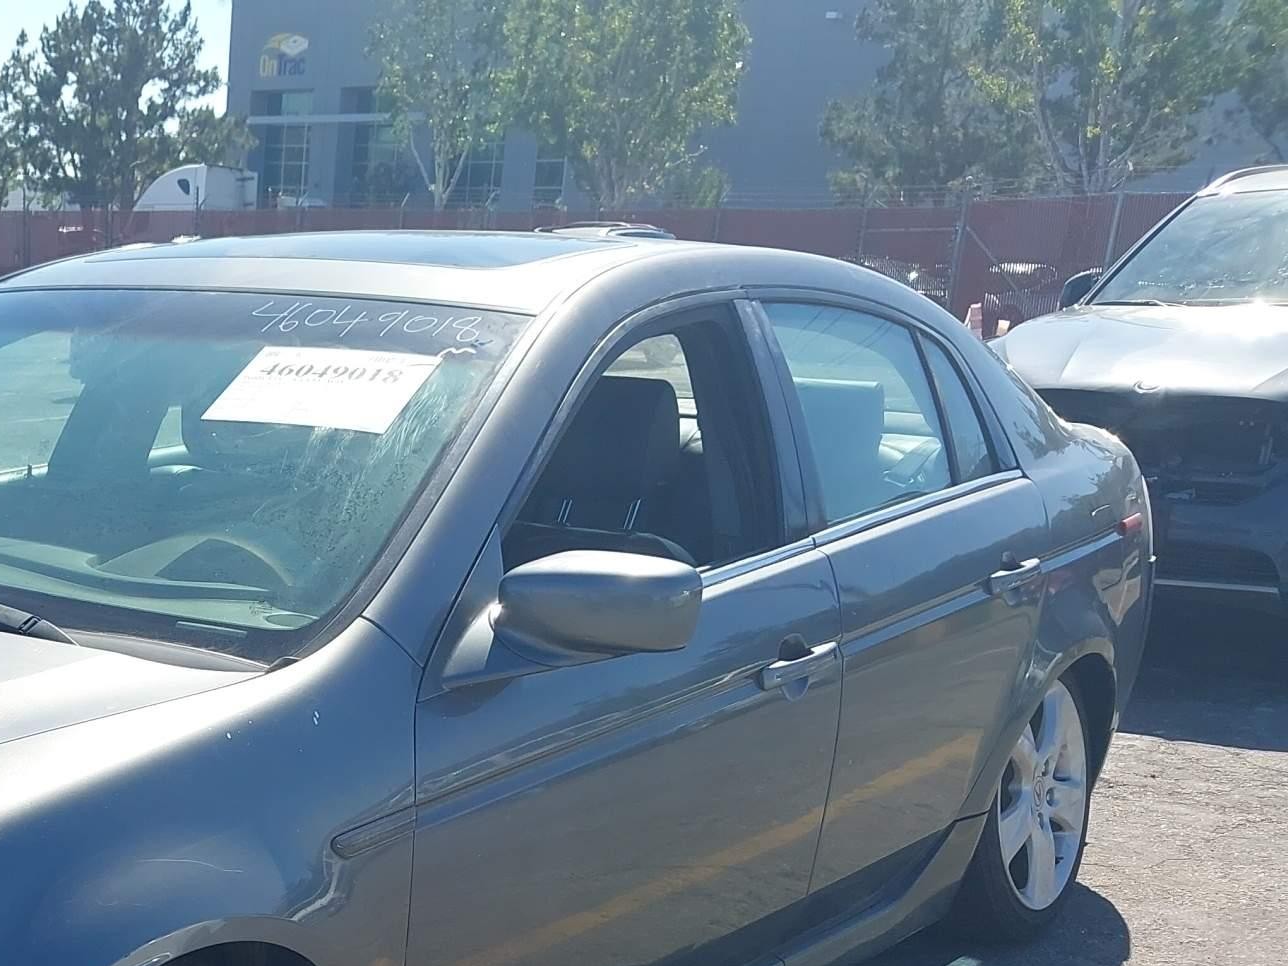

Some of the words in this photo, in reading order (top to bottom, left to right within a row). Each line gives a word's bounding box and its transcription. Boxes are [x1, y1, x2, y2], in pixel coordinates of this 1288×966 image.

[259, 53, 306, 78] OnTrac
[252, 300, 485, 343] 46049018
[259, 361, 405, 385] 46049018
